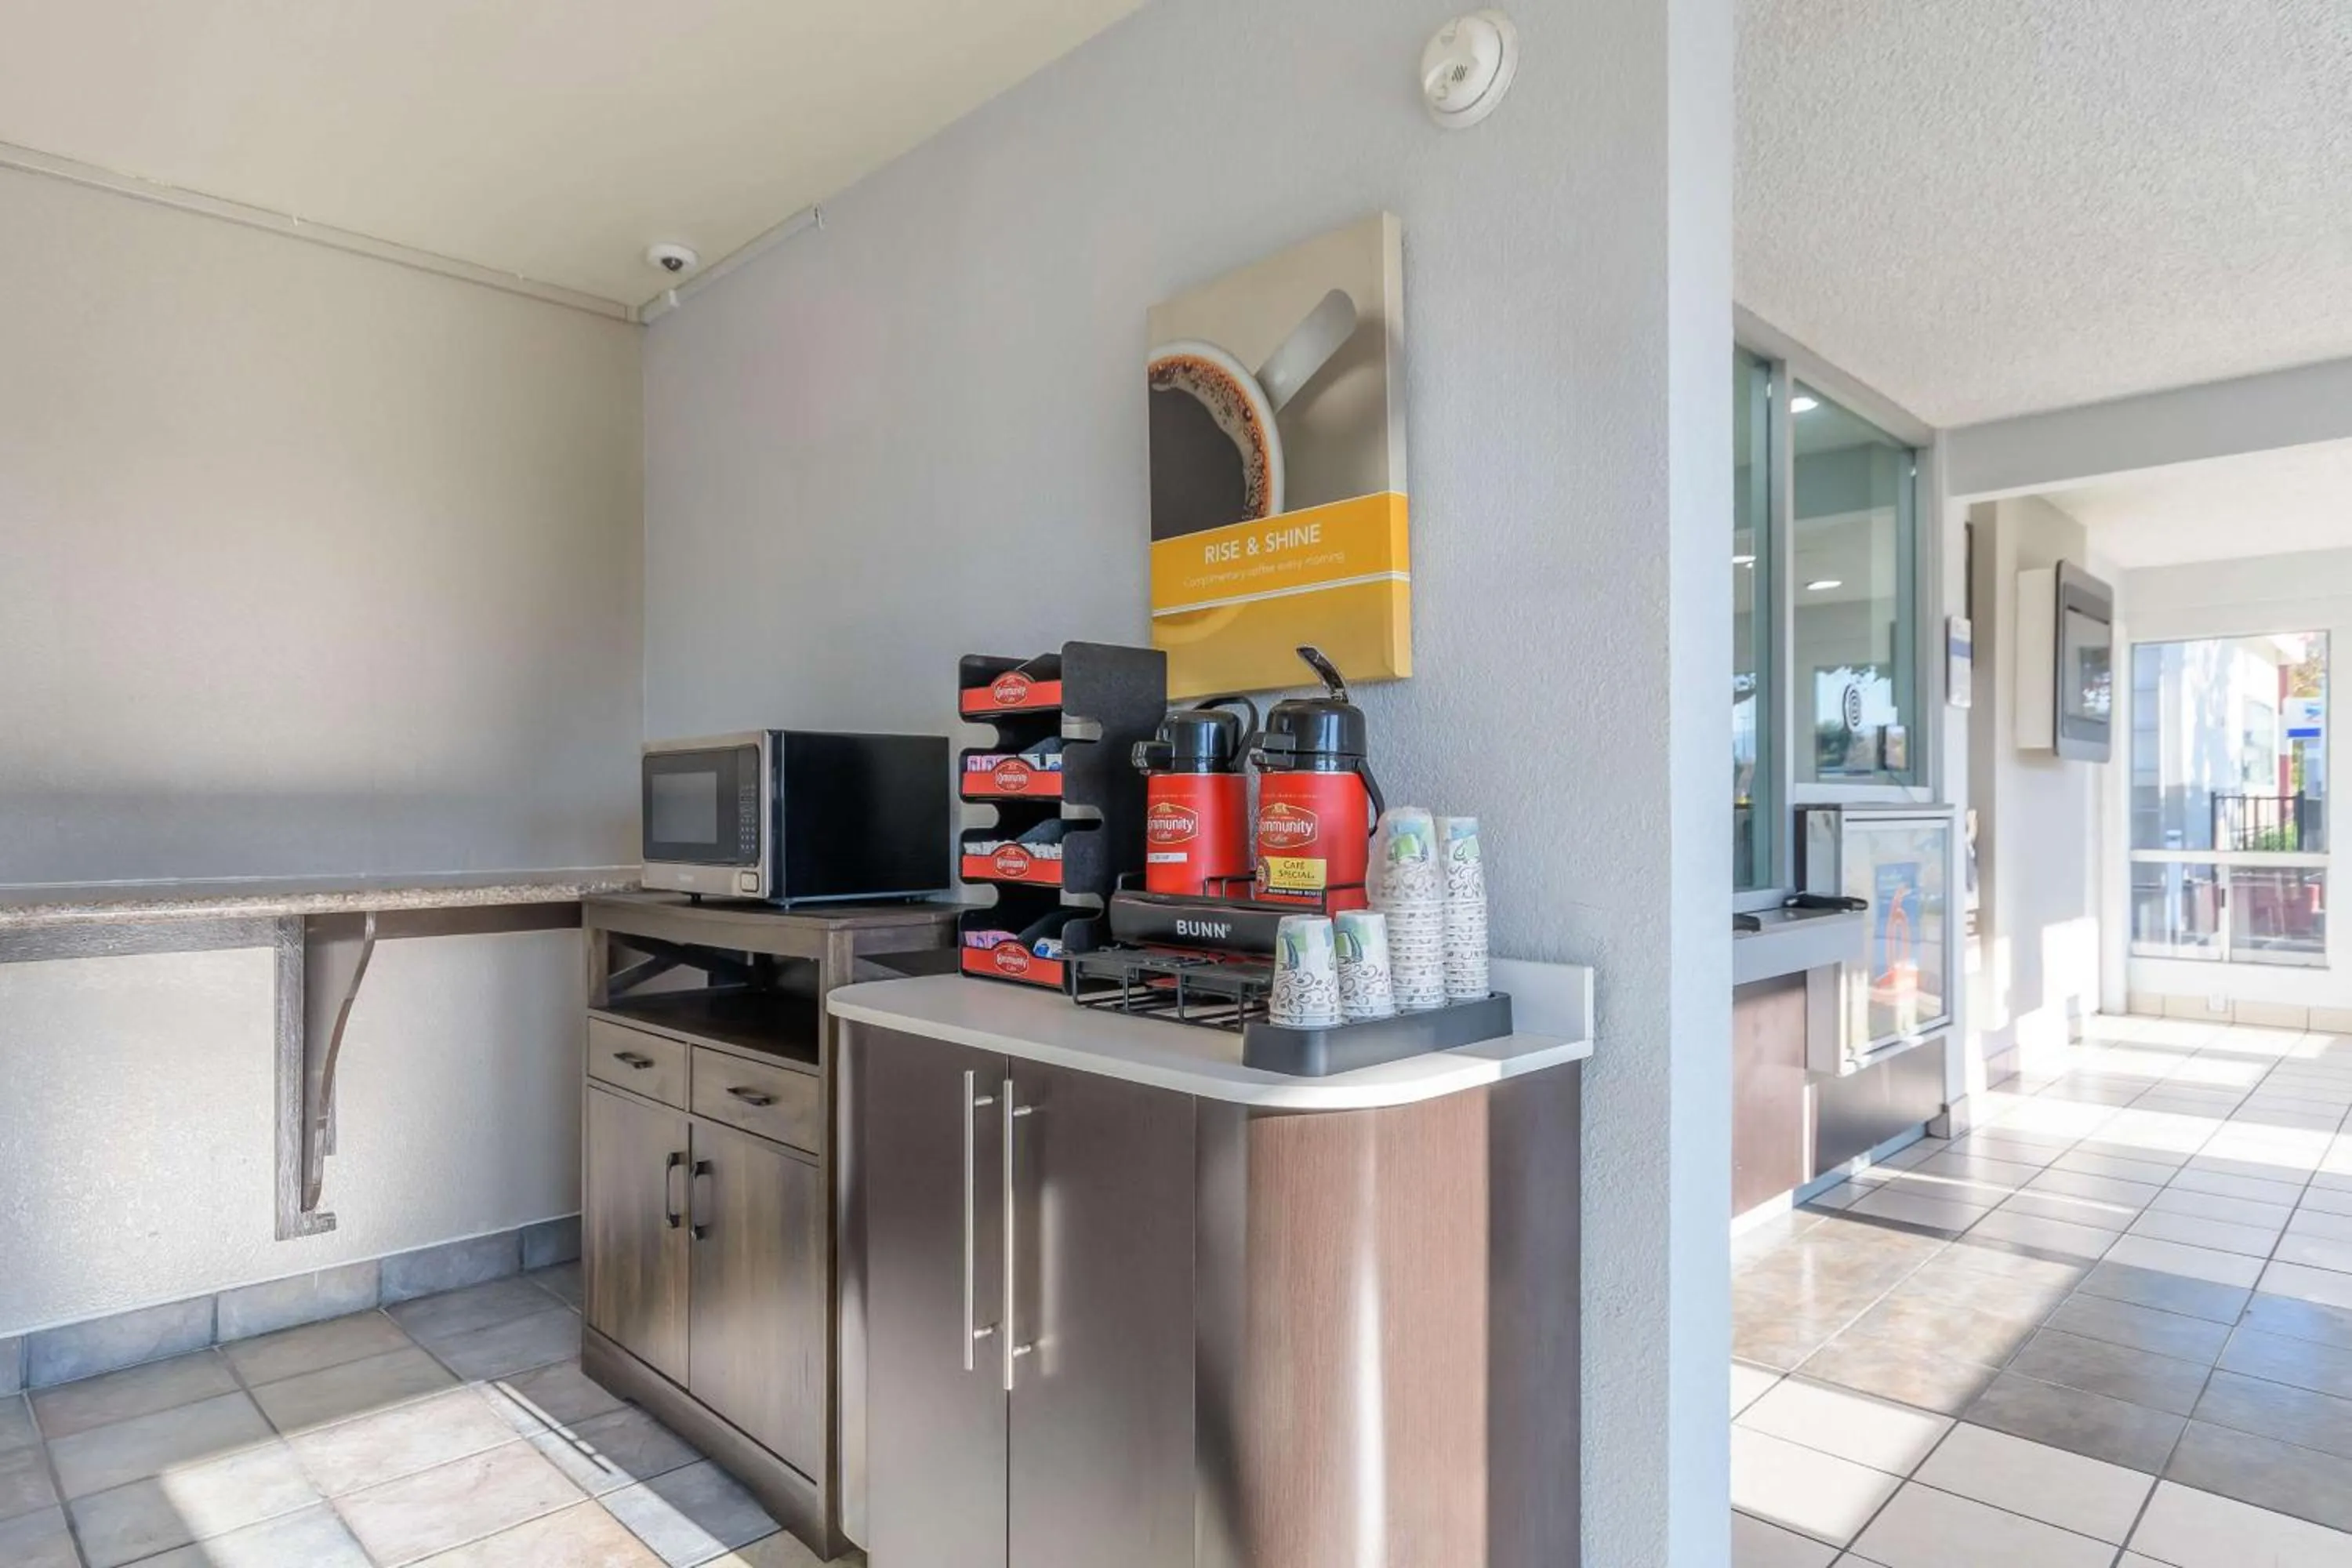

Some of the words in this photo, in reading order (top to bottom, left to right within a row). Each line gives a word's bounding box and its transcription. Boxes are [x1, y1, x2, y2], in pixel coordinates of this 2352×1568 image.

[1204, 539, 1241, 564] RISE
[1246, 536, 1259, 556] &
[1265, 524, 1322, 553] SHINE
[1147, 816, 1194, 833] ommunity
[1258, 818, 1313, 837] ommunity
